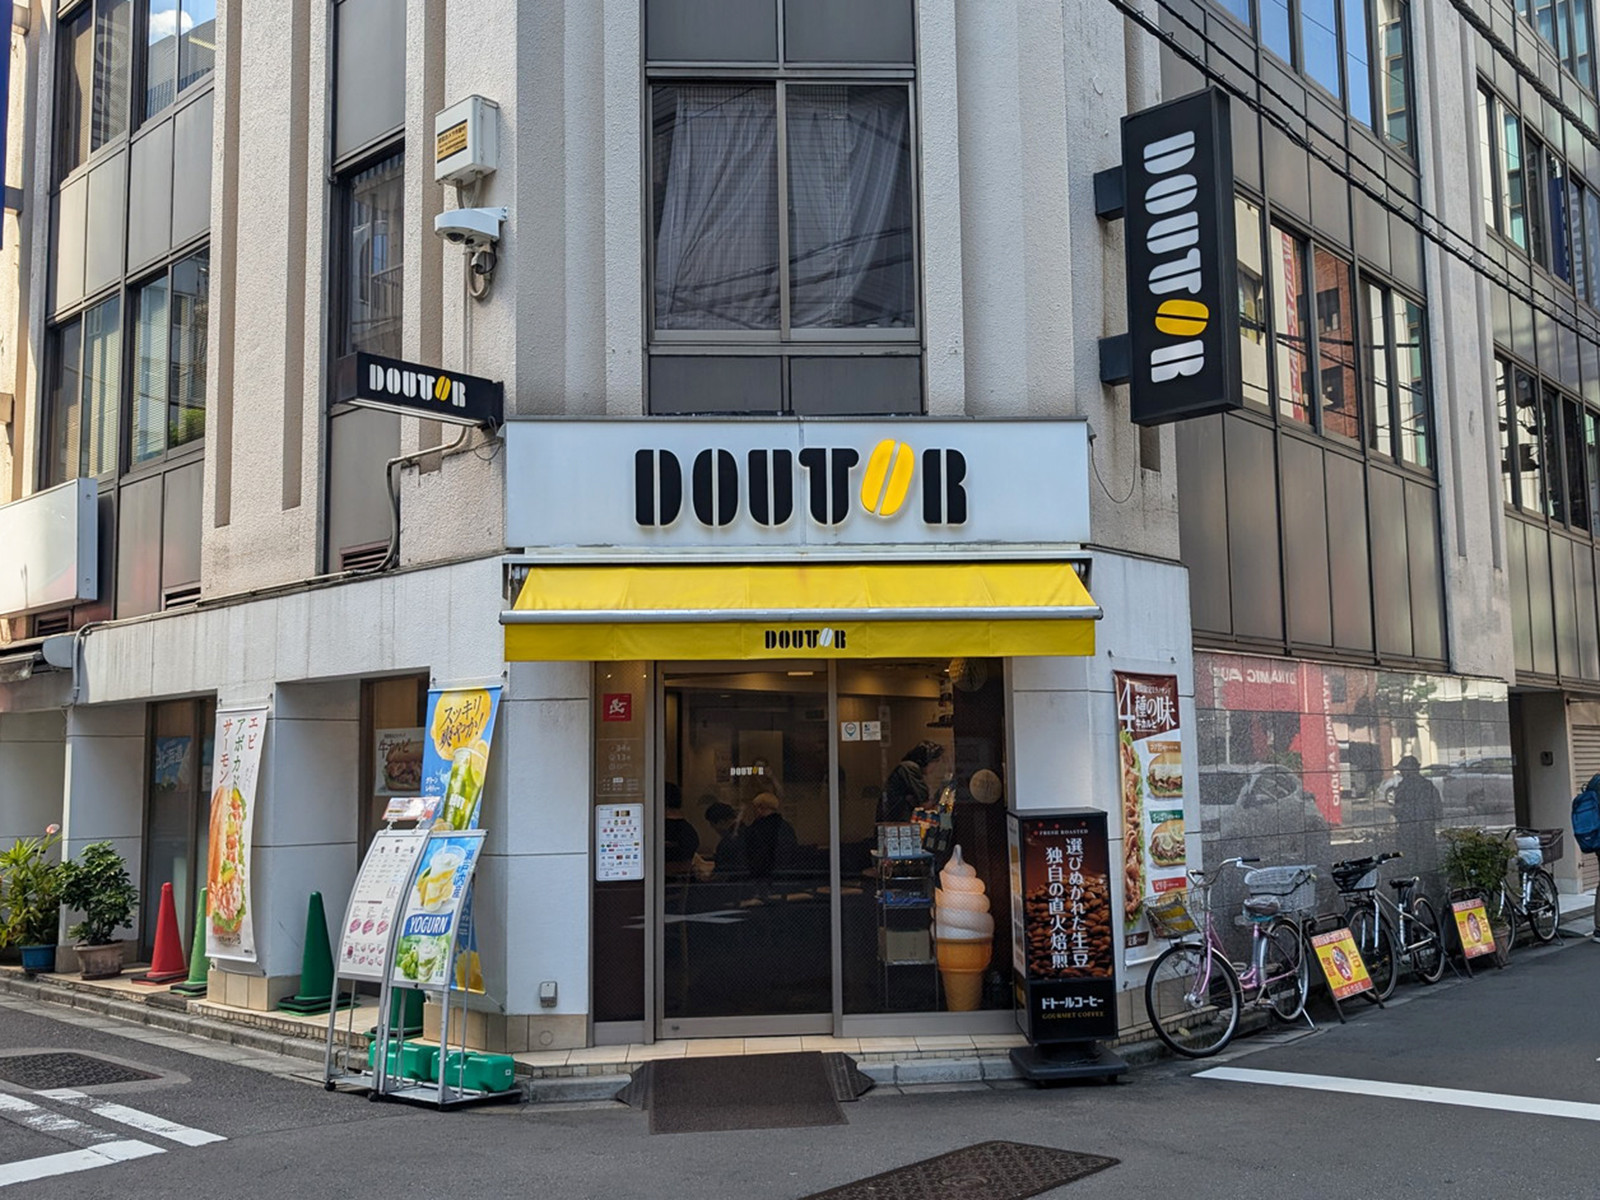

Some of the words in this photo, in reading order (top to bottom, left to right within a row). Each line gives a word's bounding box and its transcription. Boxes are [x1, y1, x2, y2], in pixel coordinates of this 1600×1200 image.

[1143, 130, 1209, 383] DOUTOR
[368, 363, 467, 408] DOUTOR
[634, 439, 967, 526] DOUTOR
[765, 628, 846, 650] DOUTOR
[439, 695, 482, 729] スッキリ
[219, 718, 233, 784] サーモン
[248, 717, 258, 749] エビ
[1046, 846, 1070, 969] 独自の直火焙煎
[1066, 837, 1091, 968] 選びぬかれた生豆
[409, 915, 449, 934] YOGURN
[1042, 995, 1104, 1010] ドトールコーヒー
[1042, 1012, 1076, 1020] GOURMET
[1078, 1010, 1104, 1018] COFFEE
